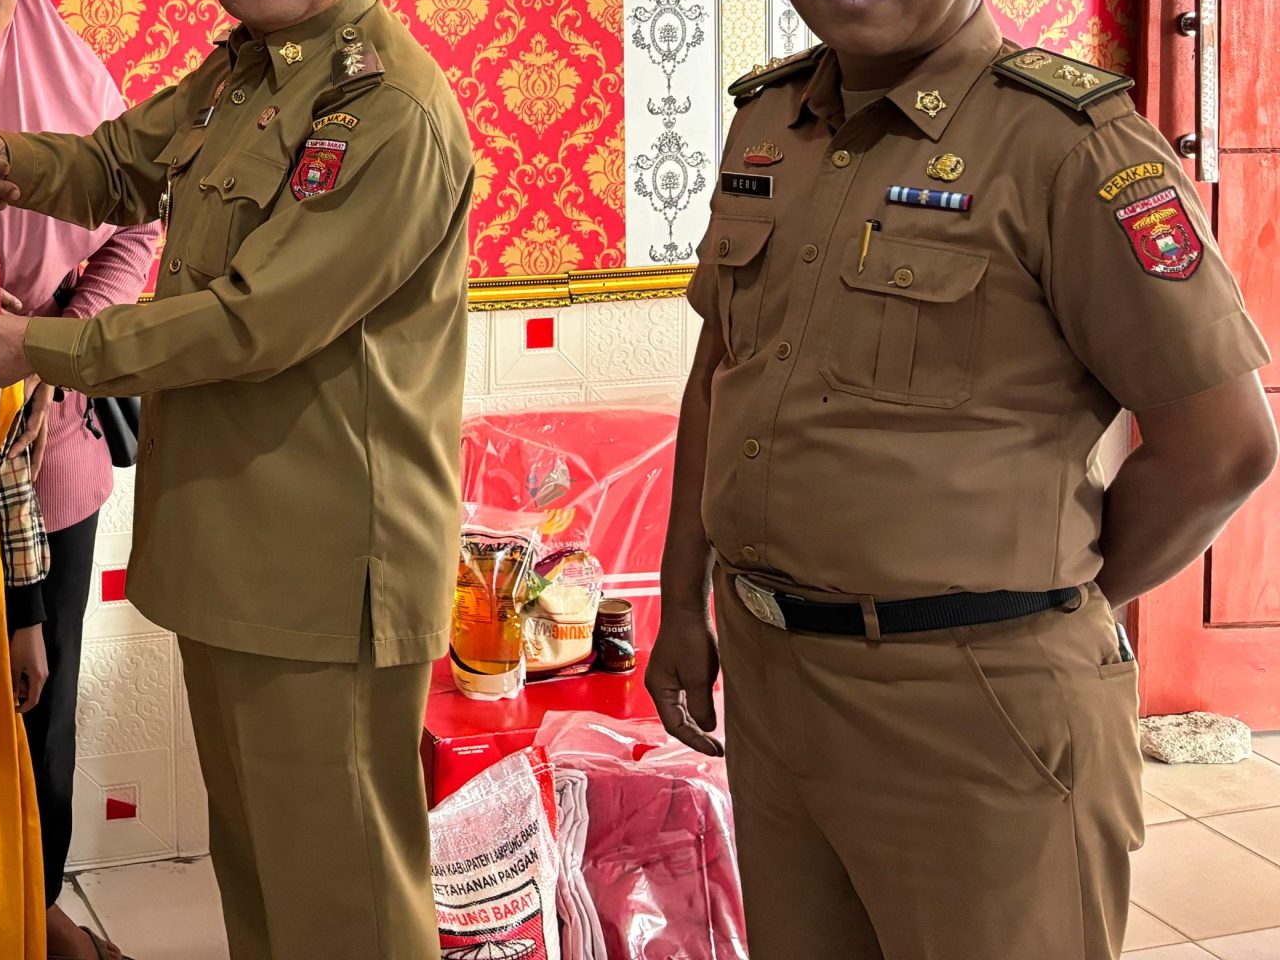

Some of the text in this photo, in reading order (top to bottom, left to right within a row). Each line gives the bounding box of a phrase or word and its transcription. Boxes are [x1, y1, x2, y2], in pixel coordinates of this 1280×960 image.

[315, 114, 355, 128] PEMKAB
[732, 178, 757, 190] HERU
[1103, 164, 1159, 196] PEMKAB
[433, 848, 539, 897] ETAHANAN PANGAN
[447, 852, 491, 876] KABUPATEN
[491, 891, 533, 921] BARAT
